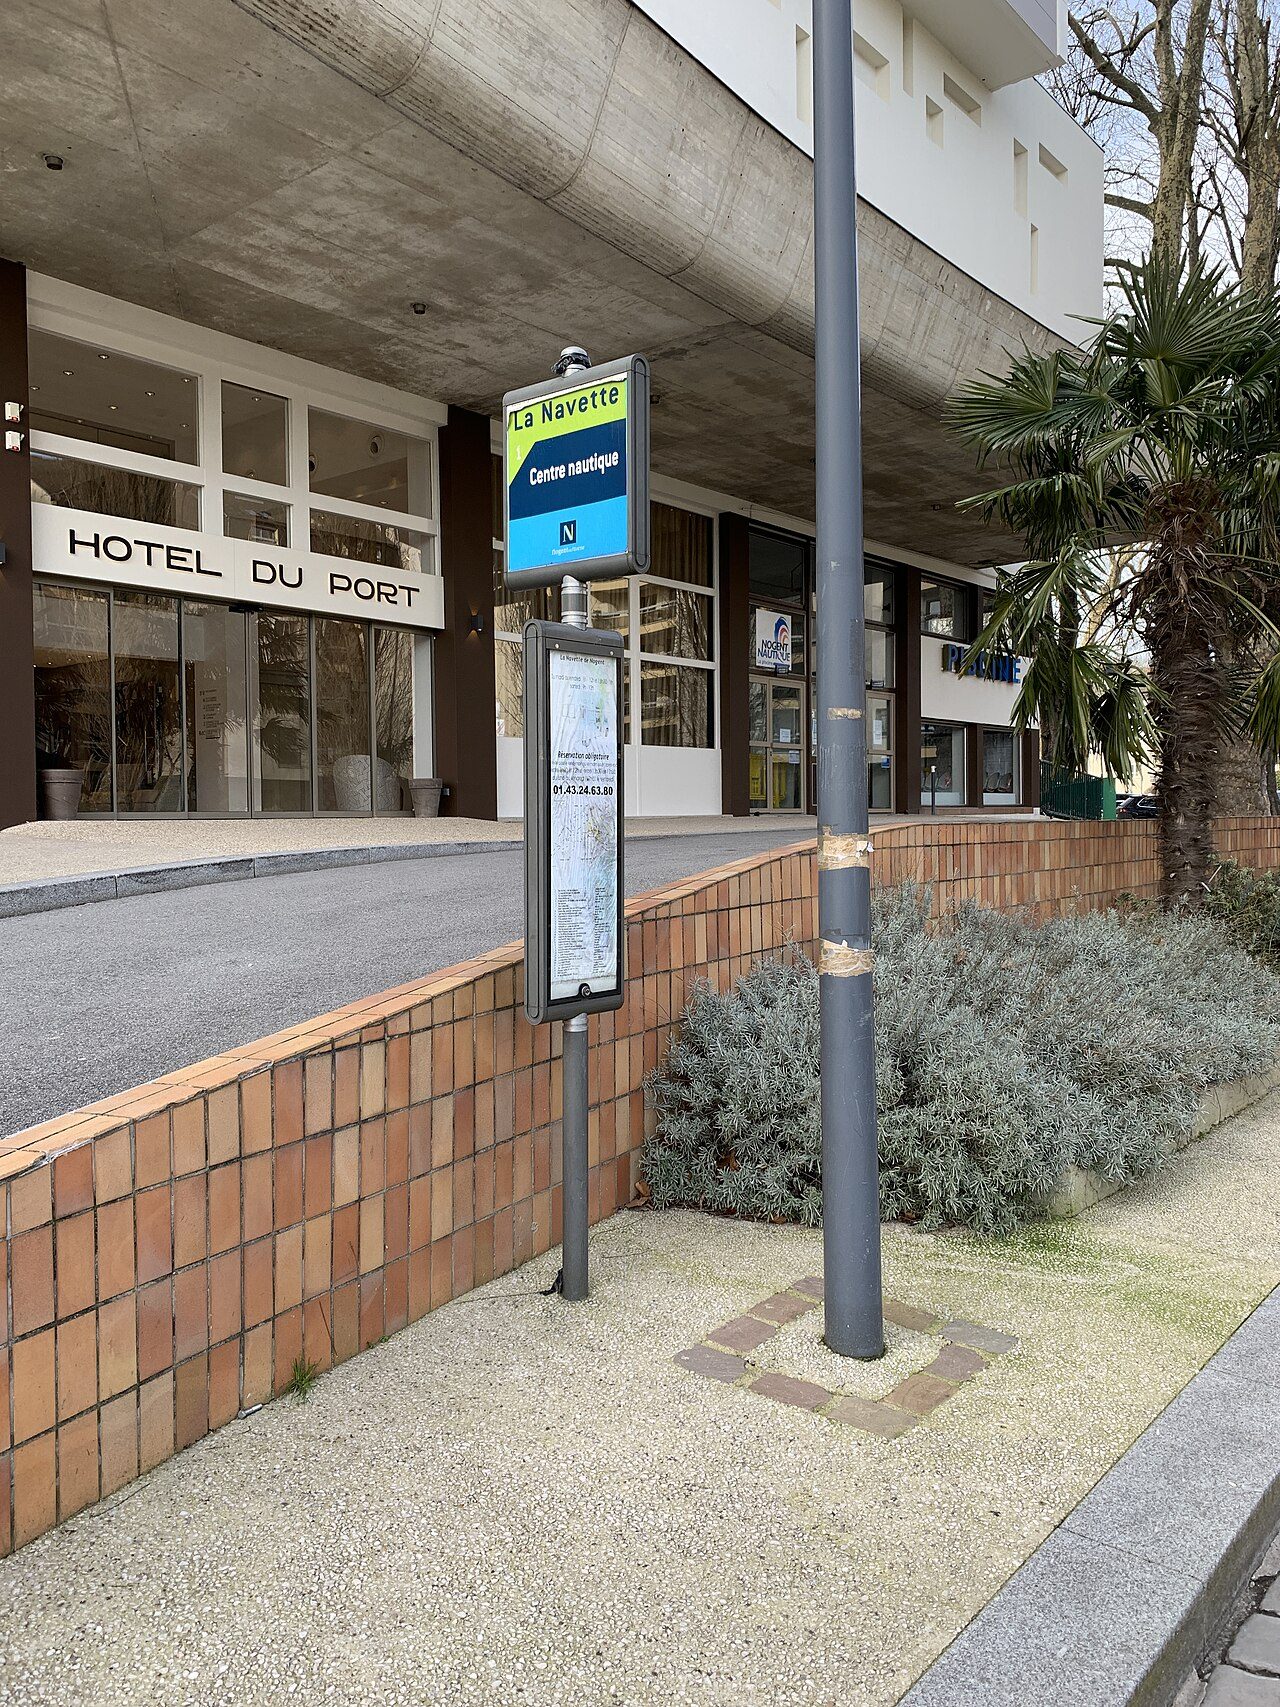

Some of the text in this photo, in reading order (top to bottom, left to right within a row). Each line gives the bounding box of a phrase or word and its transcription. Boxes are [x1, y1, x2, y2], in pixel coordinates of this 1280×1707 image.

[514, 386, 619, 431] La Navette
[529, 450, 619, 486] Centre nautique
[69, 529, 420, 607] HOTEL DU PORT
[761, 639, 789, 652] NOGENT
[585, 752, 610, 761] obligatoire
[553, 785, 613, 796] 01.43.24.63.80
